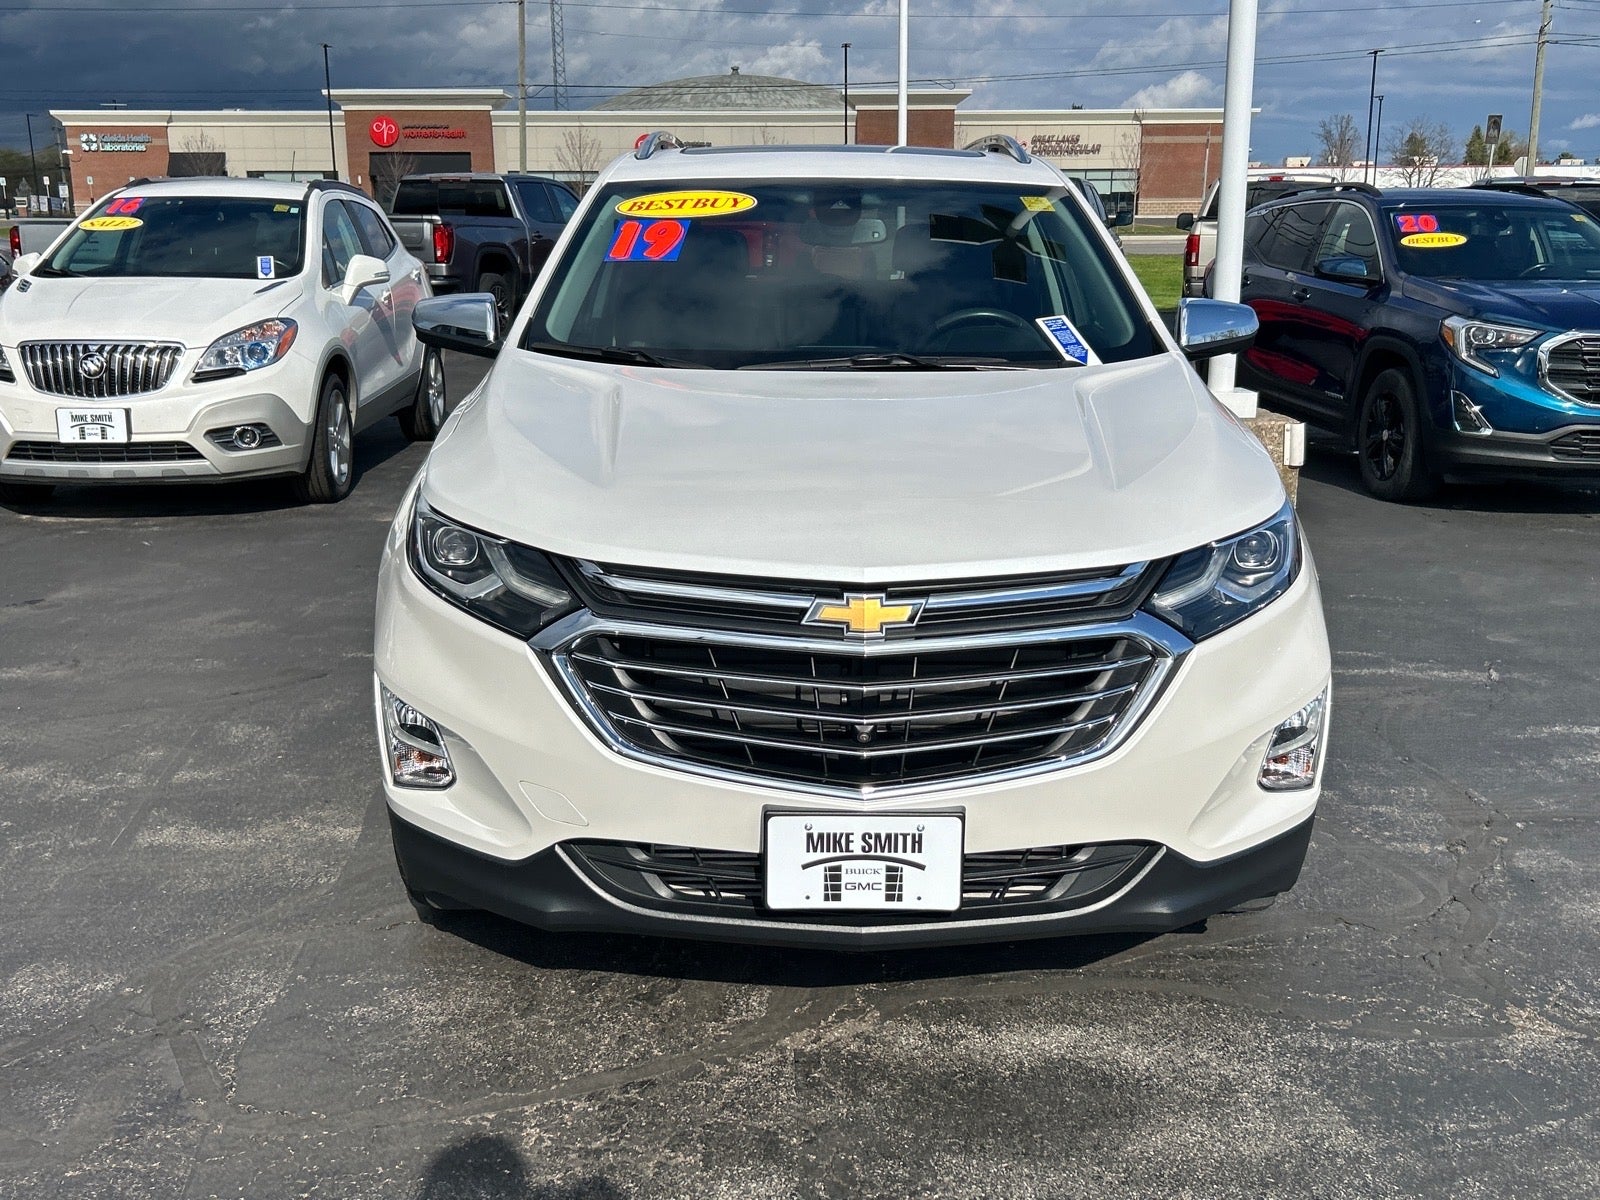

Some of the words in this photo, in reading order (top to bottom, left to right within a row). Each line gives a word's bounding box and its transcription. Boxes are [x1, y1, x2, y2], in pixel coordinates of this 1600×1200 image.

[1031, 134, 1055, 145] GREAT
[1056, 134, 1081, 145] LAKES
[99, 142, 147, 152] Laboratories
[1031, 144, 1101, 157] CARDIOVASCULAR
[106, 197, 143, 214] 16
[626, 199, 693, 212] BEST
[692, 197, 747, 209] BUY
[1398, 214, 1439, 233] 20
[609, 219, 685, 260] 19
[70, 414, 89, 423] MIKE
[90, 414, 113, 423] SMITH
[805, 832, 855, 854] MIKE
[860, 832, 923, 854] SMITH
[844, 882, 883, 891] GMC
